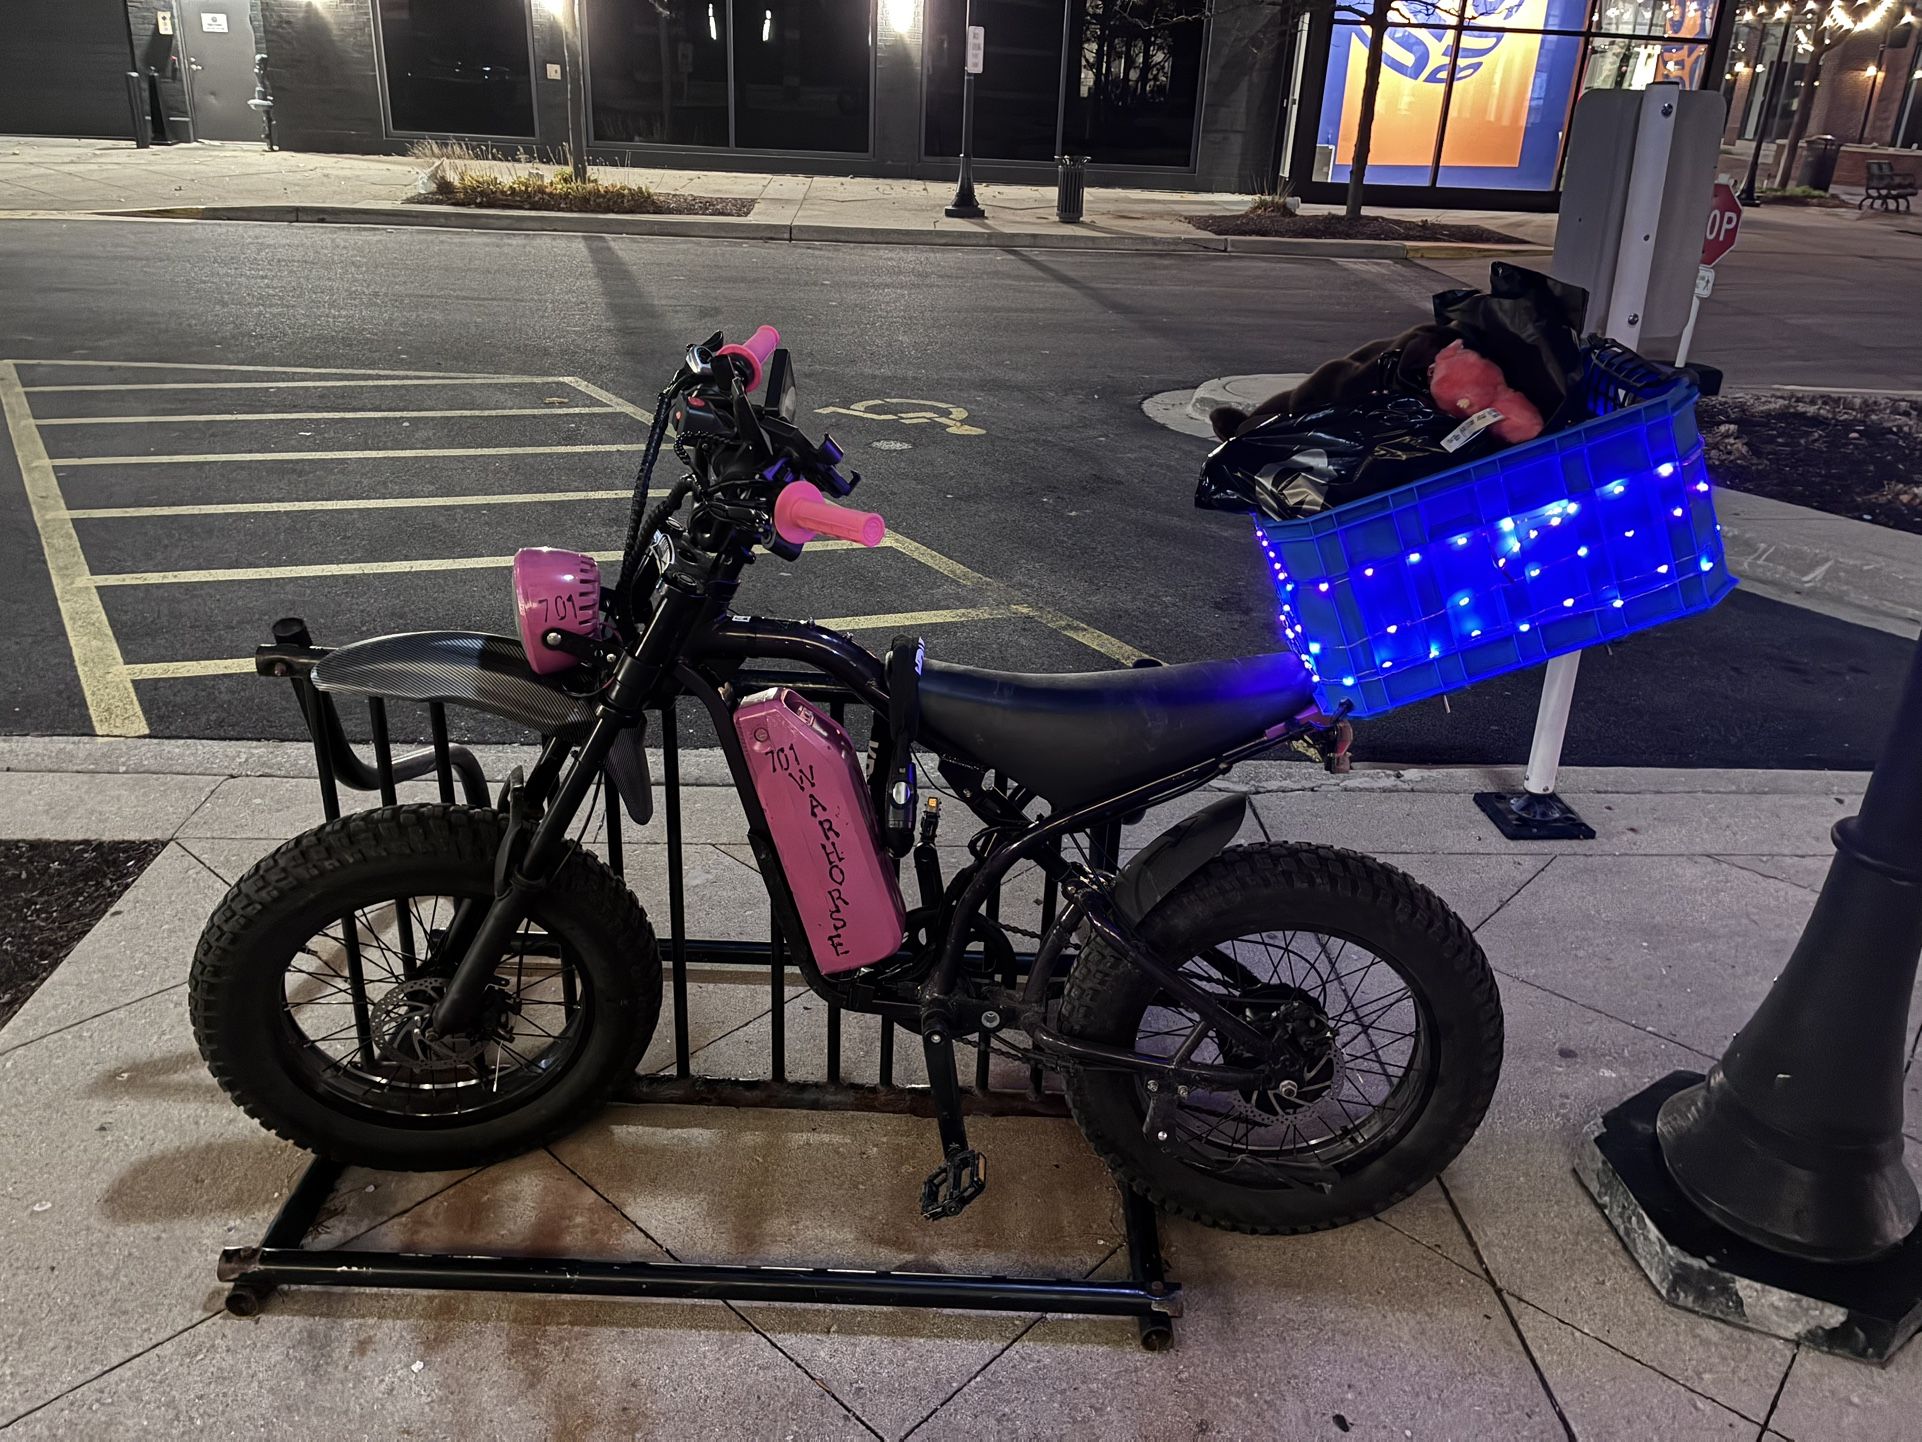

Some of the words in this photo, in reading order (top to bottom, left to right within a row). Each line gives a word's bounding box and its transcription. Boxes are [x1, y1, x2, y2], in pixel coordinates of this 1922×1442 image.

[1706, 209, 1737, 241] OP
[538, 593, 578, 623] 701
[765, 743, 800, 774] 701
[788, 765, 850, 957] WARHORSE
